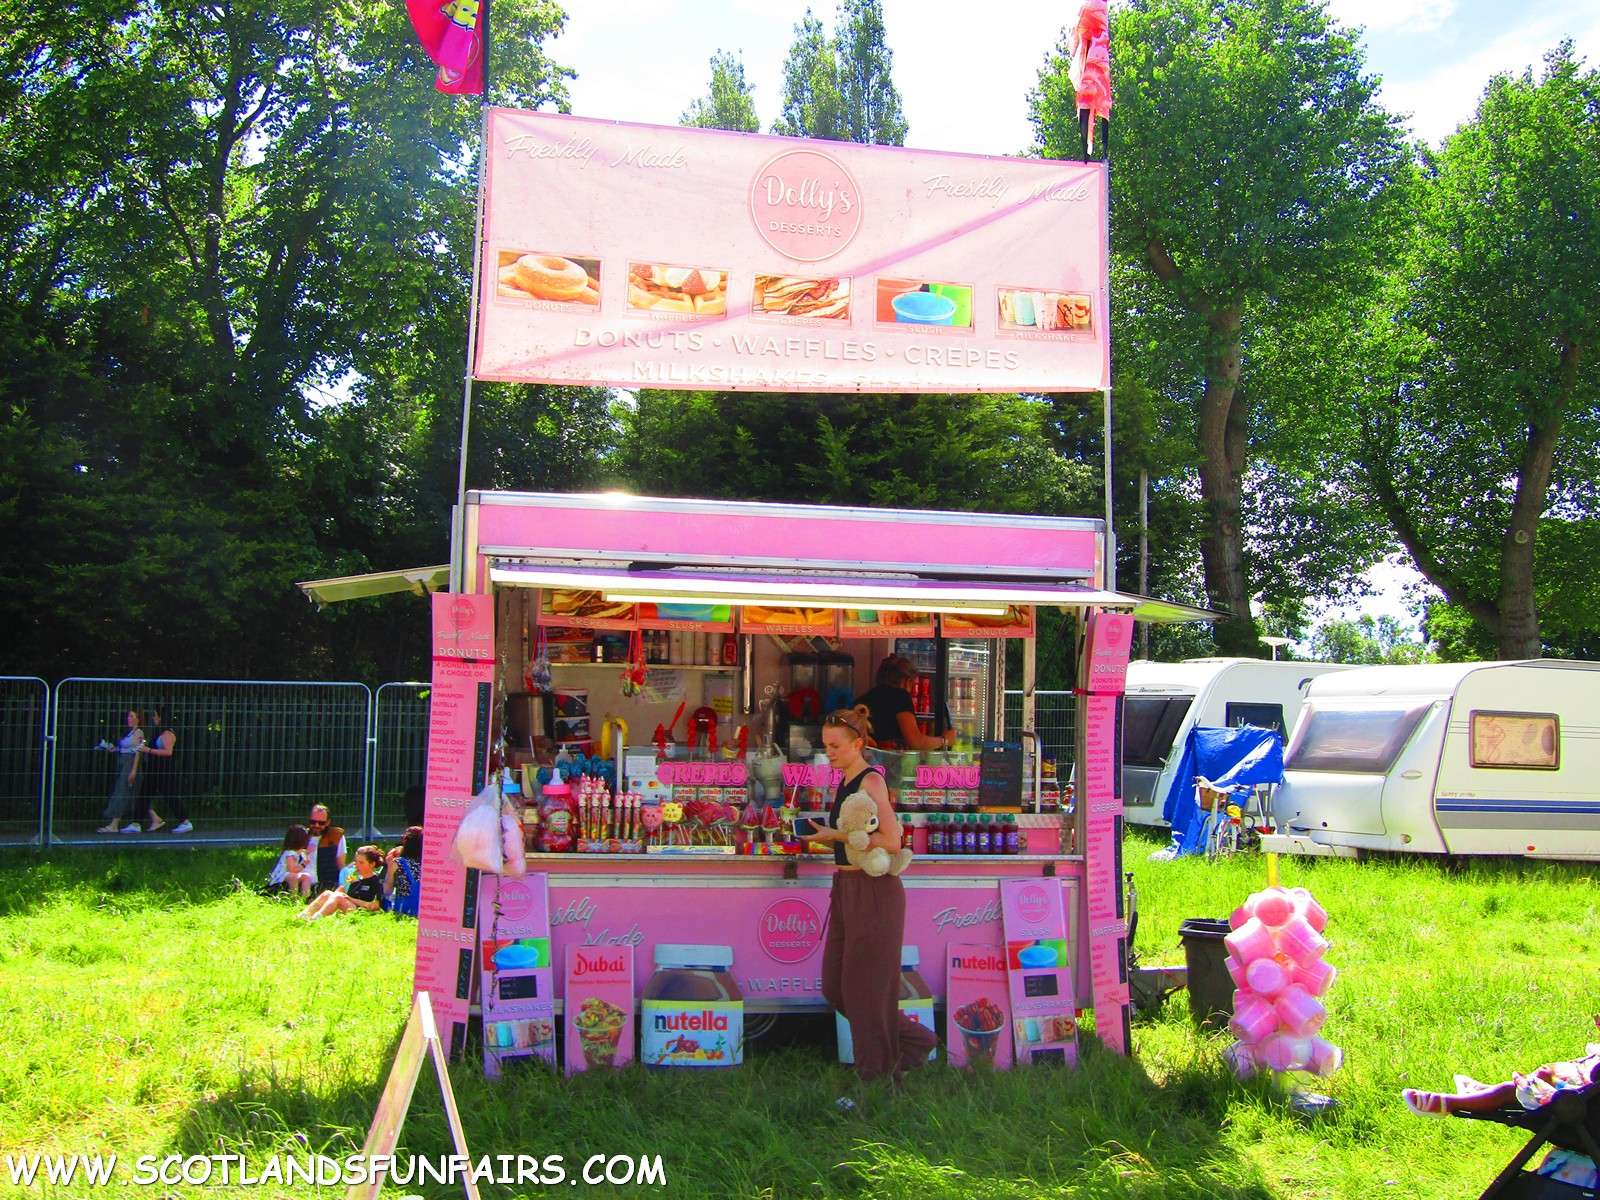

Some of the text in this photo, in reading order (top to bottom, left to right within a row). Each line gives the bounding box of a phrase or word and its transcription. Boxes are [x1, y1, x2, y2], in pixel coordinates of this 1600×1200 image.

[504, 134, 688, 168] Freshly Made
[922, 173, 1090, 207] Freshly Made
[762, 174, 854, 222] Dolly's
[770, 221, 842, 237] DESSERTS
[524, 301, 572, 313] DONUTS
[649, 312, 702, 322] WAFFLES
[780, 317, 823, 327] CREPES
[908, 325, 942, 335] SLUSH
[1015, 332, 1077, 343] MILKSHAKE
[574, 327, 1021, 370] DONUTS WAFFLES CREPES
[568, 617, 609, 628] CREPES
[669, 622, 702, 630] SLUSH
[766, 624, 813, 634] WAFFLES
[859, 628, 916, 636] MILKSHAKE
[968, 628, 1009, 636] DONUTS
[439, 648, 488, 658] DONUTS
[1094, 665, 1125, 673] DONUTS
[657, 762, 747, 786] CREPES
[433, 797, 471, 808] CREPE
[1092, 803, 1119, 812] CREPES
[932, 900, 1003, 936] Freshl
[766, 914, 817, 940] Dolly's
[1021, 928, 1050, 936] SLUSH
[421, 928, 474, 943] WAFFLES
[584, 923, 644, 946] Made
[574, 953, 625, 976] Dubai
[952, 955, 1007, 971] nutella
[748, 978, 822, 992] WAFFLE
[1014, 1000, 1073, 1011] MILKSHAKES
[654, 1010, 728, 1031] nutella
